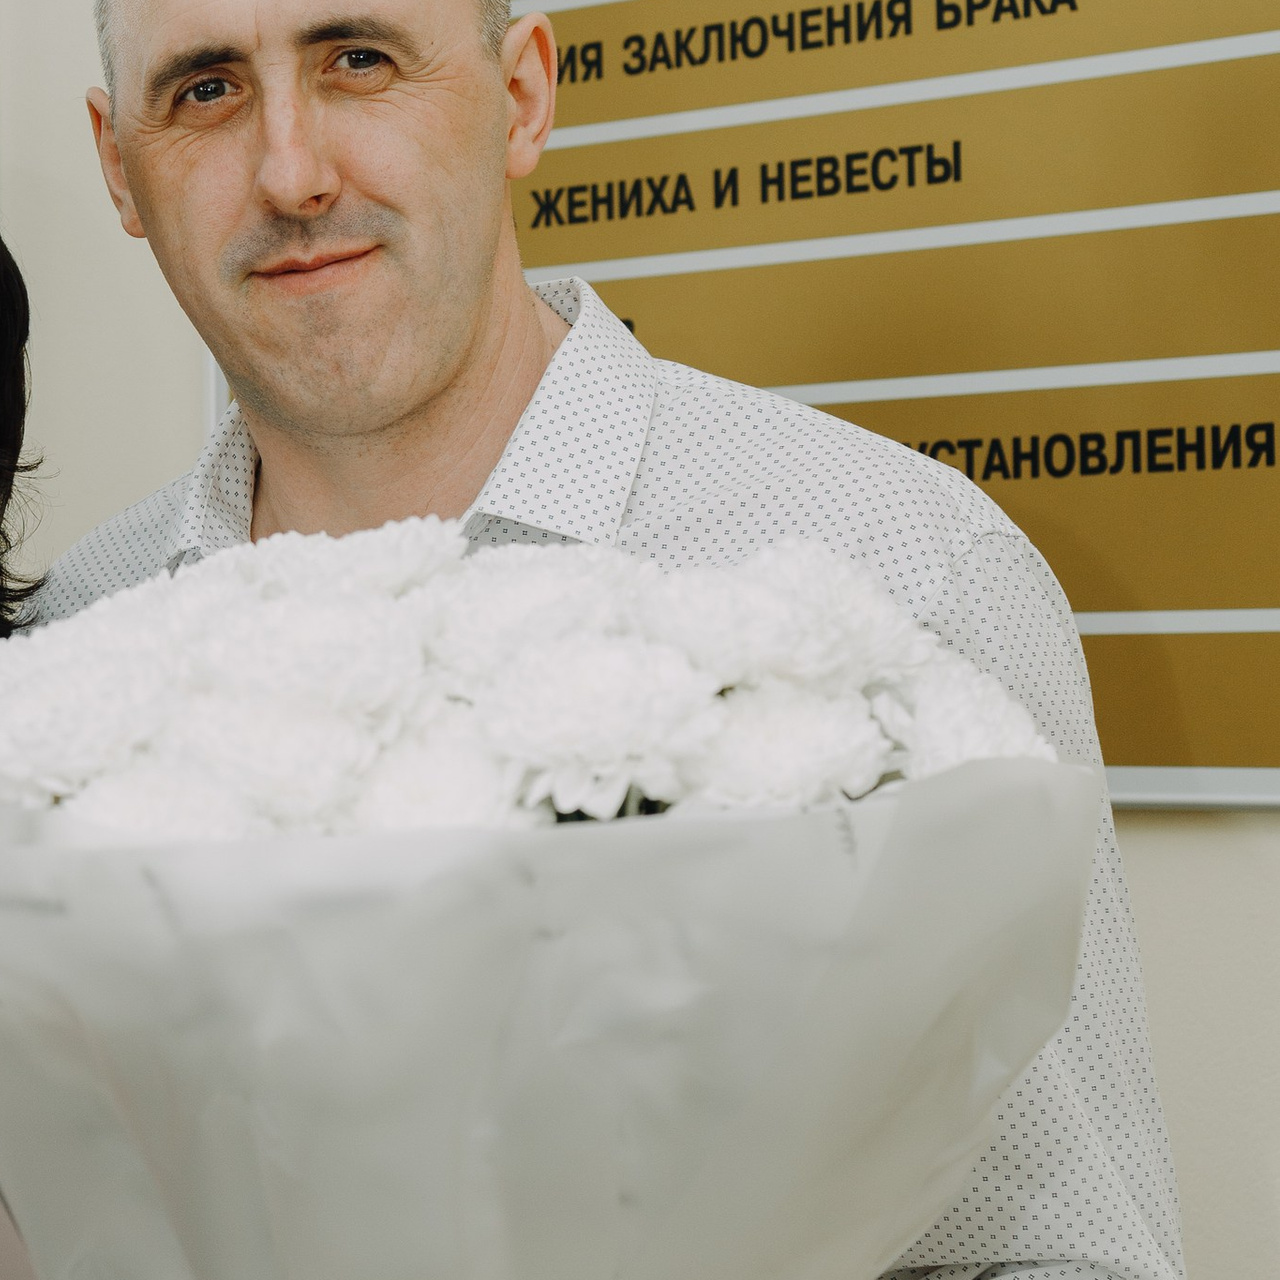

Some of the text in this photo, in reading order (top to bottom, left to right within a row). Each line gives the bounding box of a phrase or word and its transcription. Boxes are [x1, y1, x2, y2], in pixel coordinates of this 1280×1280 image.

[529, 139, 964, 231] ЖЕНИХА И НЕВЕСТЫ
